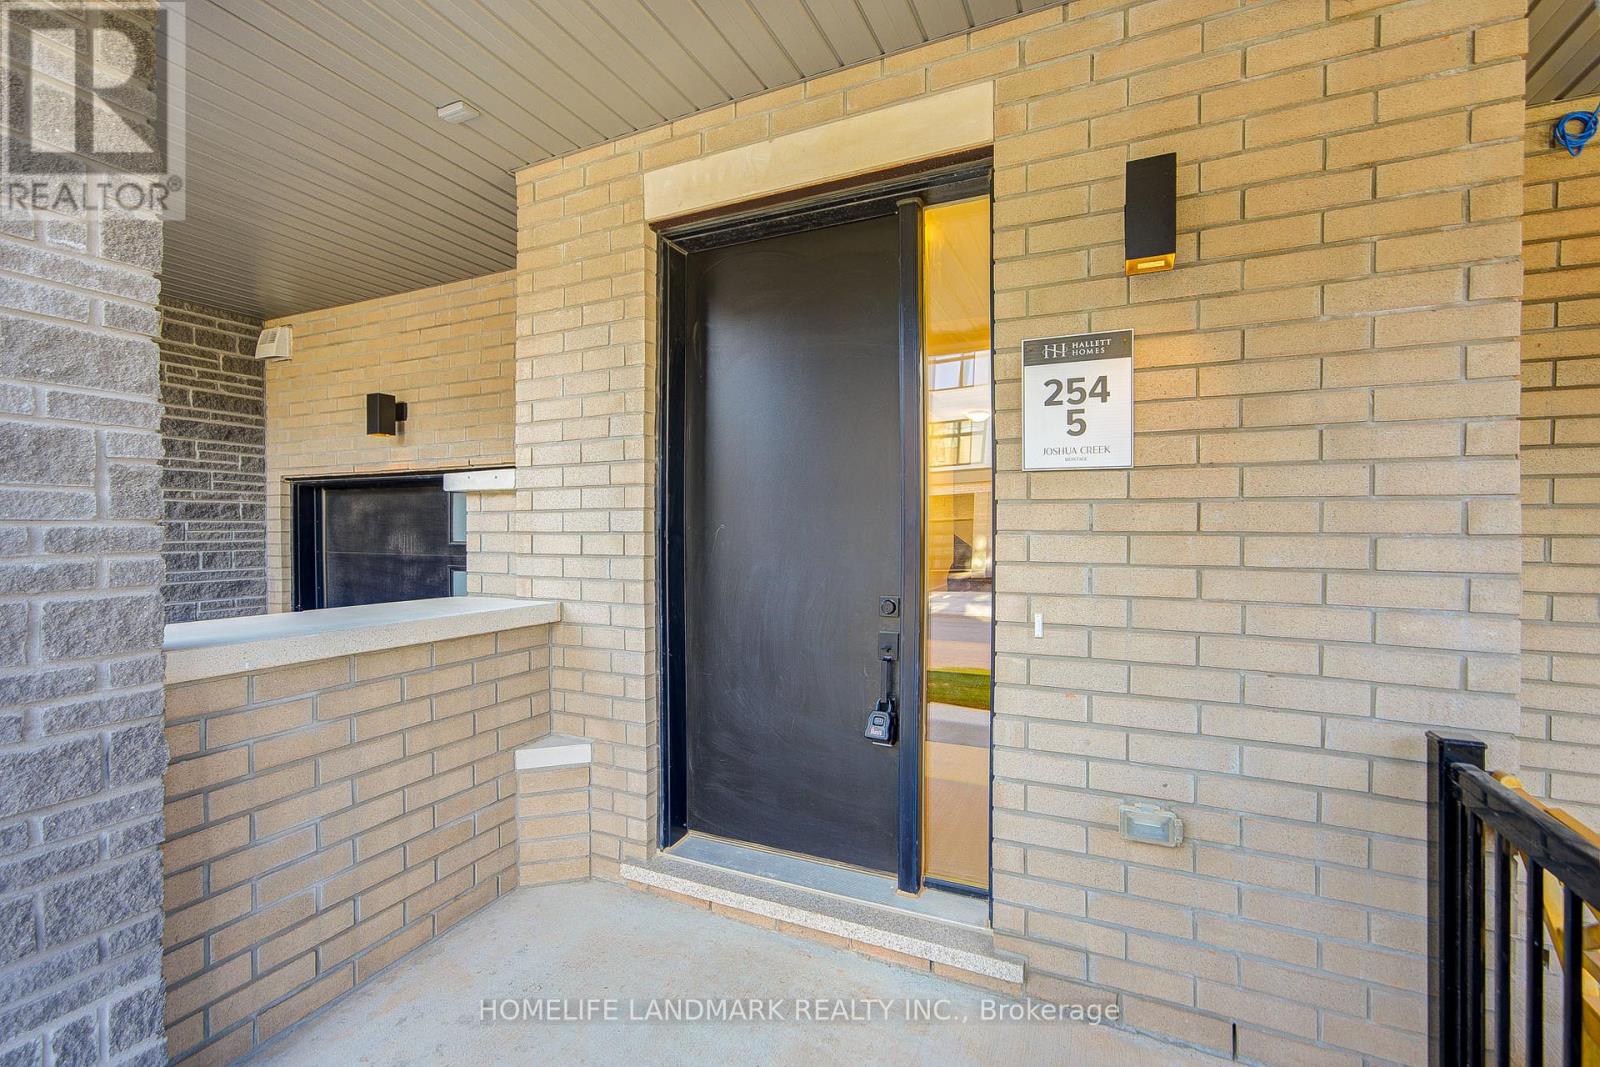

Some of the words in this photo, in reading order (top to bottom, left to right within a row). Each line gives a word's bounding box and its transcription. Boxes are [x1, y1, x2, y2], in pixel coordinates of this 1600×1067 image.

[1072, 338, 1112, 349] HALLETT
[1072, 347, 1105, 356] HOMES
[1043, 375, 1111, 407] 254
[1066, 408, 1087, 437] 5
[1042, 446, 1077, 456] JOSHUA
[1080, 445, 1111, 454] CREEK
